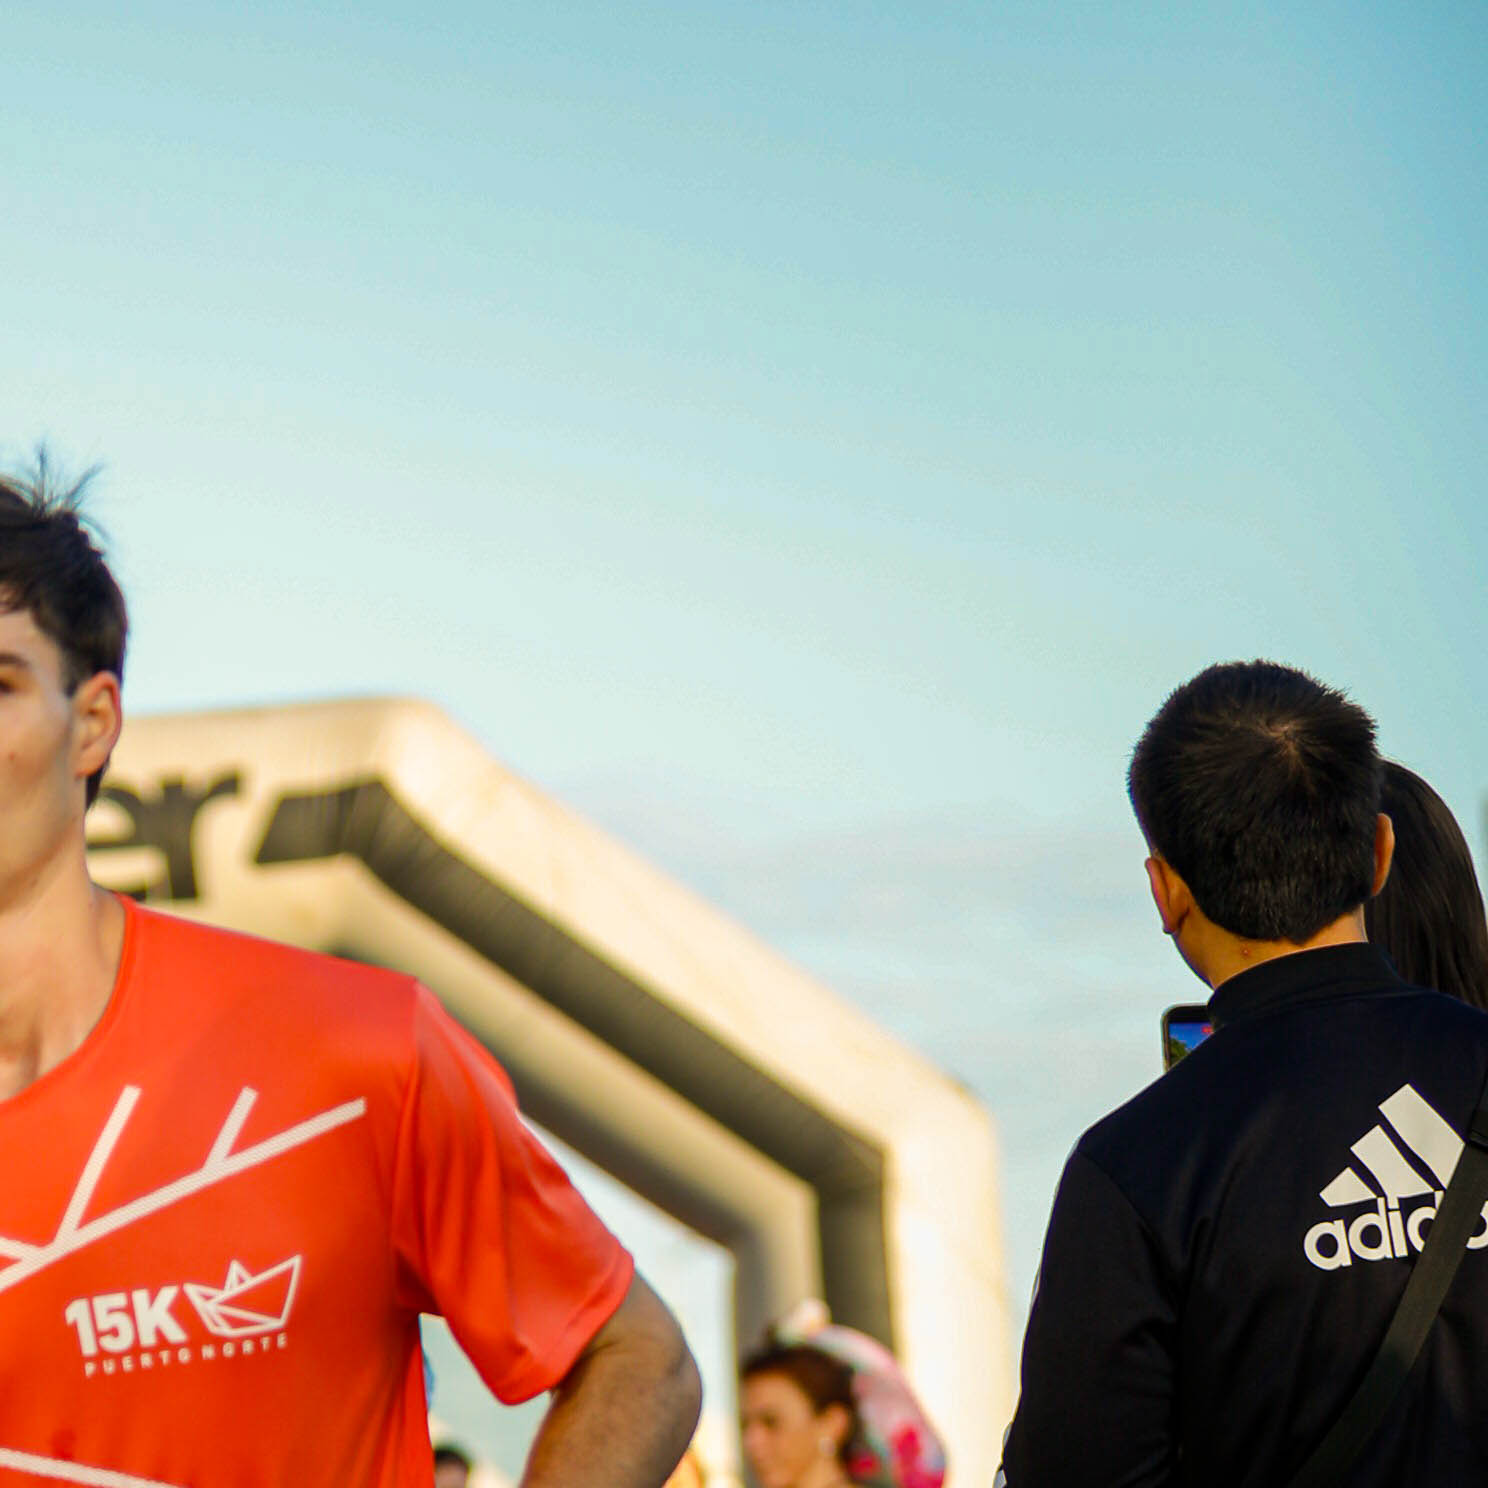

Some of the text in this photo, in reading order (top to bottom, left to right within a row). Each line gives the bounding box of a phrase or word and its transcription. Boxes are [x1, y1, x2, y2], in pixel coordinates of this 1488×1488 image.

[65, 1285, 188, 1357] 15K
[84, 1331, 288, 1379] PUERTO NORTE
